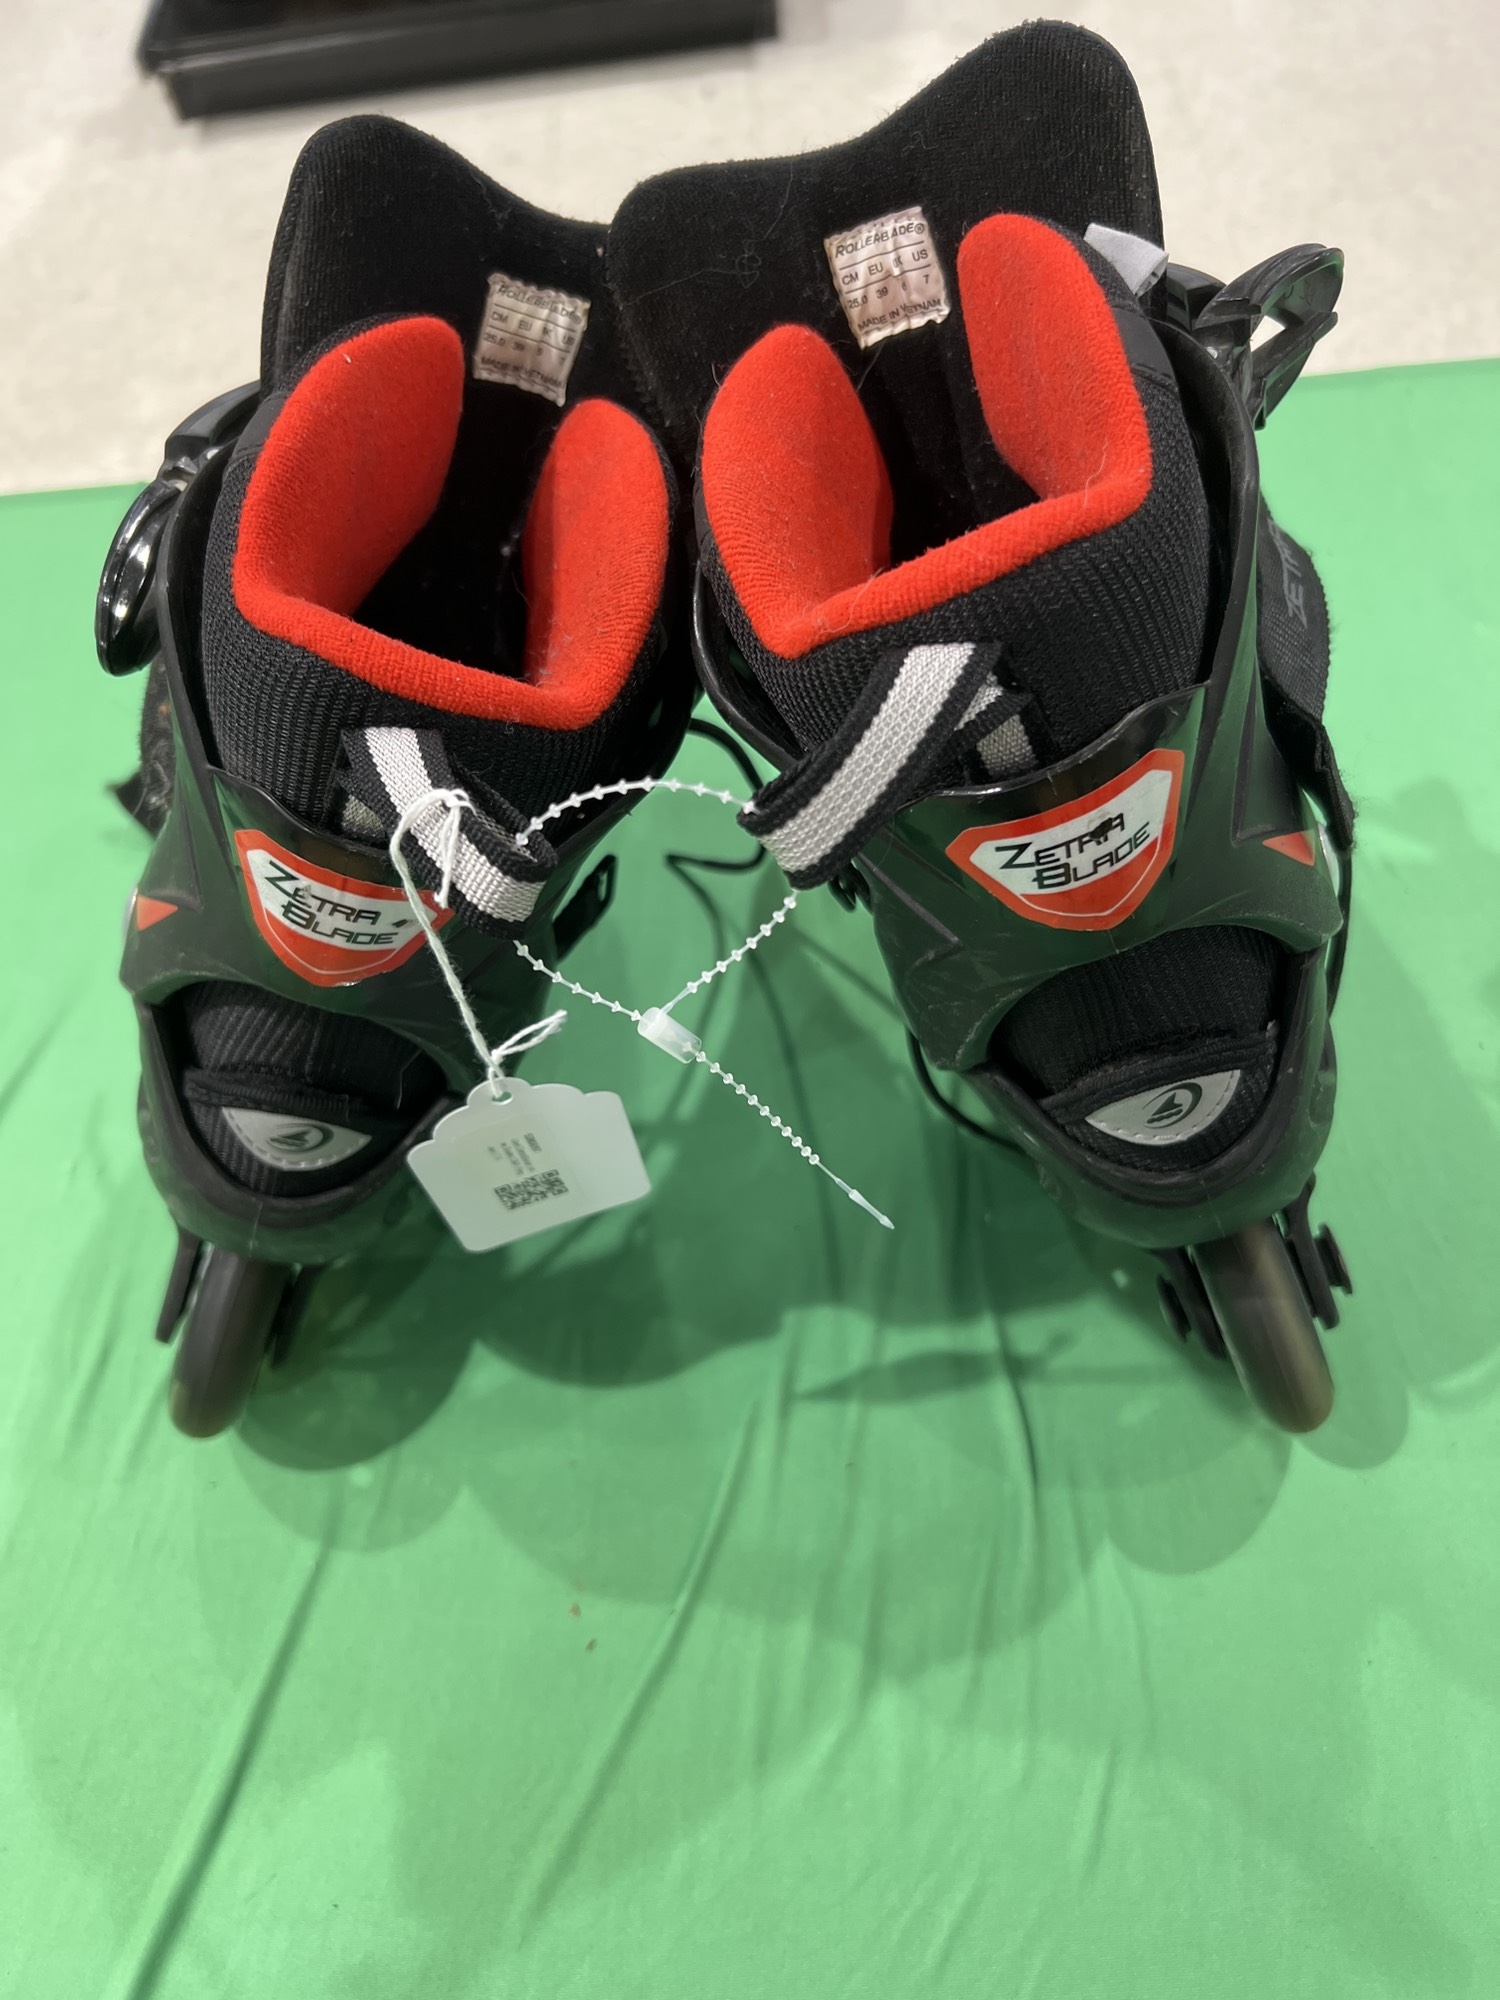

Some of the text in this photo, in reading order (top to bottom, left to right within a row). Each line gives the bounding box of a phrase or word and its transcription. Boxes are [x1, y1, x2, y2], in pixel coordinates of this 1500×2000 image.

[835, 222, 925, 259] ROLLERBADE®
[841, 272, 859, 285] CM
[868, 263, 883, 276] EU
[912, 249, 928, 262] US
[847, 295, 868, 309] 25.0
[922, 274, 929, 284] 7
[491, 311, 508, 323] CM
[519, 320, 532, 331] EU
[857, 299, 940, 331] MADE IN VETNAM
[1031, 821, 1150, 890] BLADE
[265, 860, 382, 926] ZETRA
[281, 900, 399, 946] BLADE
